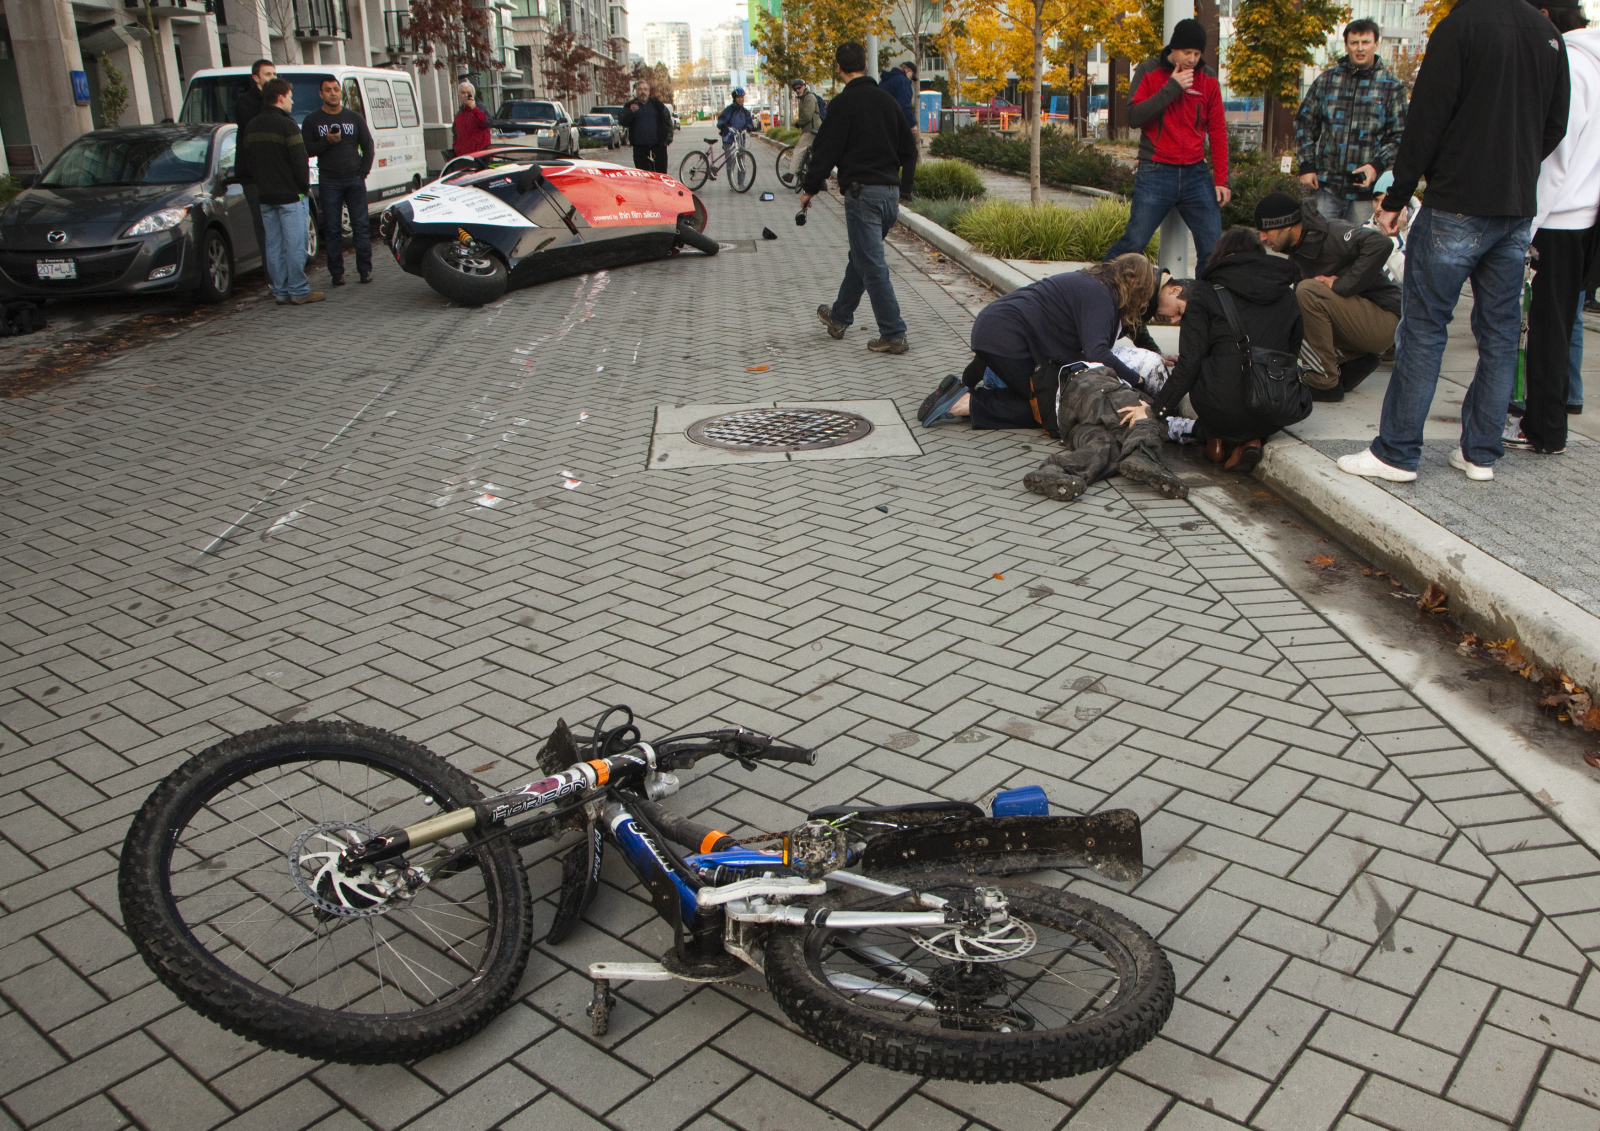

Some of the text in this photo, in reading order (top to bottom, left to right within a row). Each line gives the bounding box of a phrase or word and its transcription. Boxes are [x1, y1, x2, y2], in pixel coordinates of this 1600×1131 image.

[593, 214, 612, 222] powered
[619, 211, 630, 219] thin
[631, 210, 642, 219] film
[643, 210, 661, 219] silicon
[1264, 218, 1282, 228] FINN
[38, 264, 54, 275] 207
[492, 777, 587, 822] HORIZON
